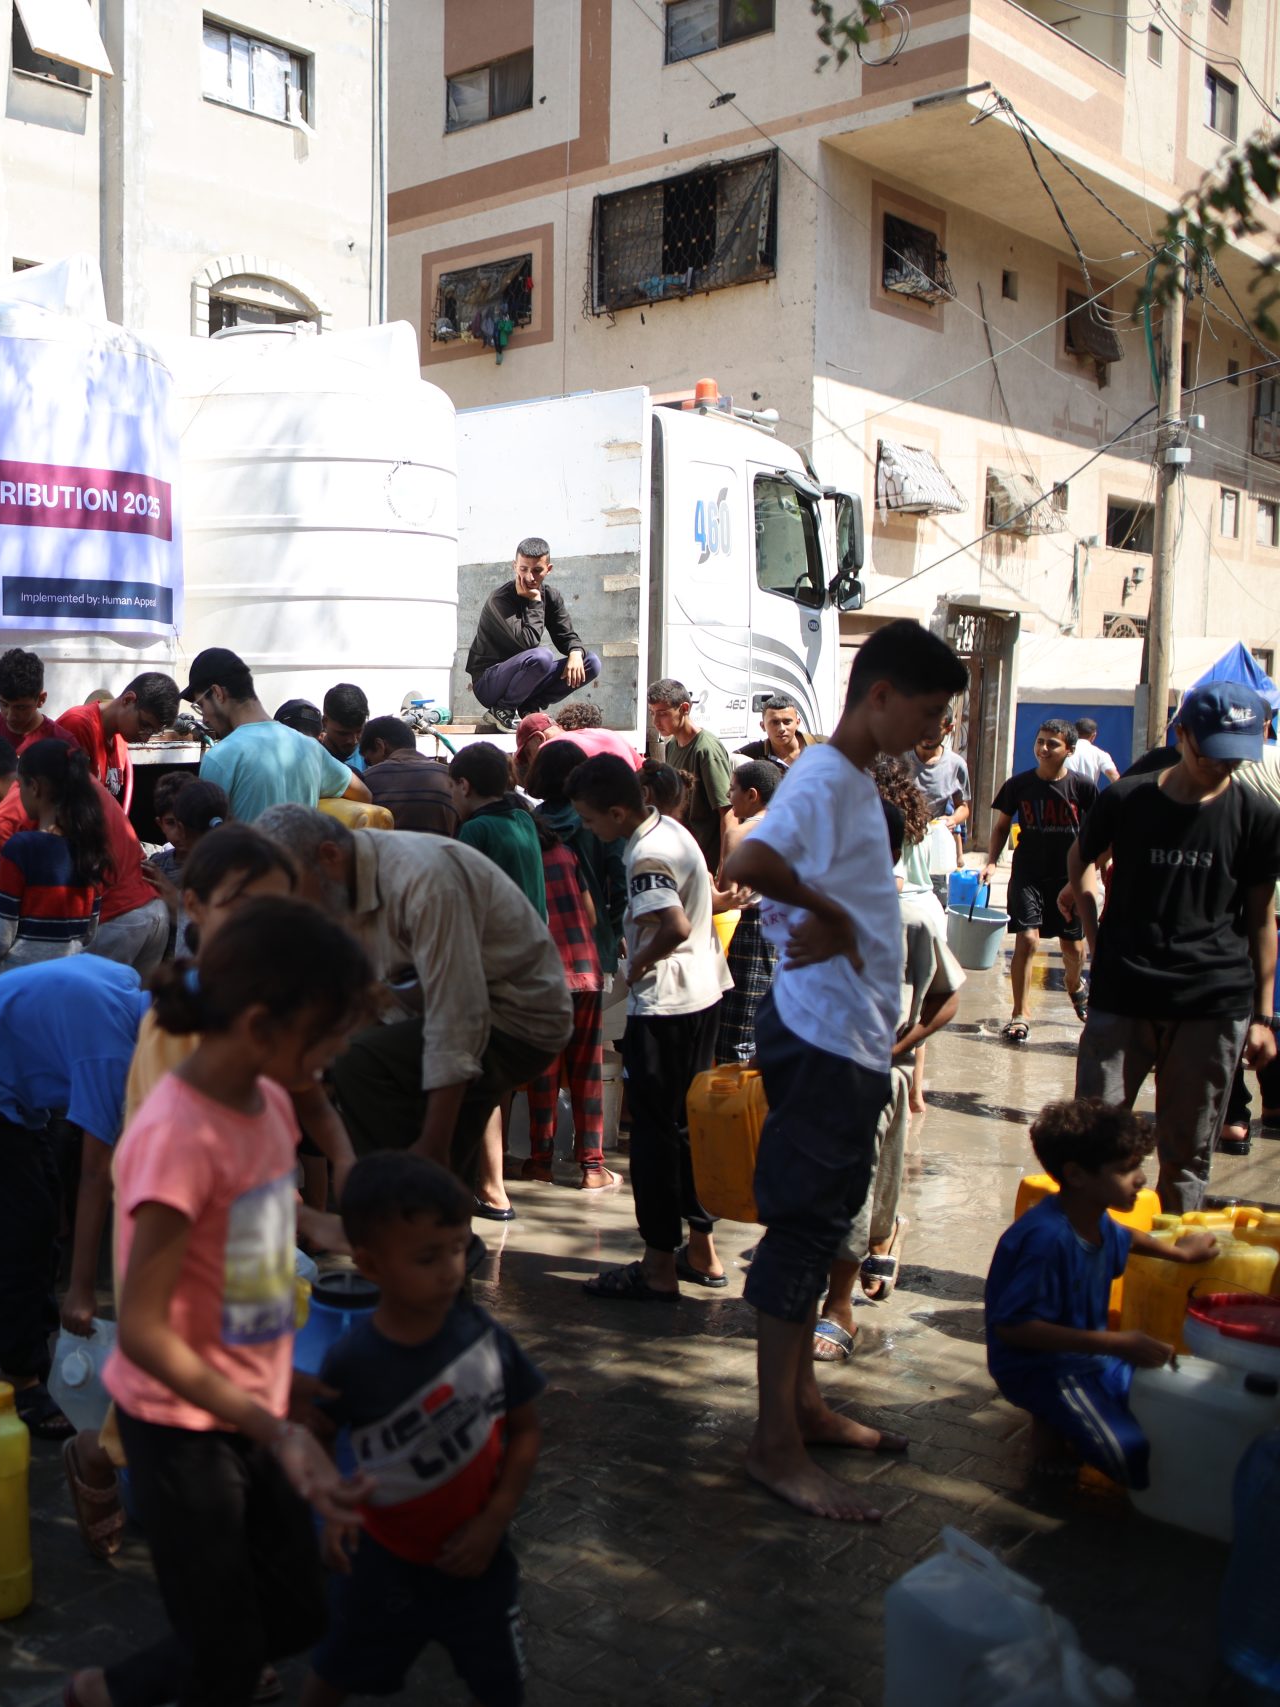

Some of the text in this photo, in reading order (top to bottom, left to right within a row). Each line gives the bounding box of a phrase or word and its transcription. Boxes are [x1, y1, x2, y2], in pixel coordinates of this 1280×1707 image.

[123, 491, 161, 519] 2025
[694, 499, 732, 556] 460
[21, 592, 157, 607] Implemented by: Human Appeal
[1229, 707, 1253, 719] NIKE
[1150, 849, 1214, 867] BOSS
